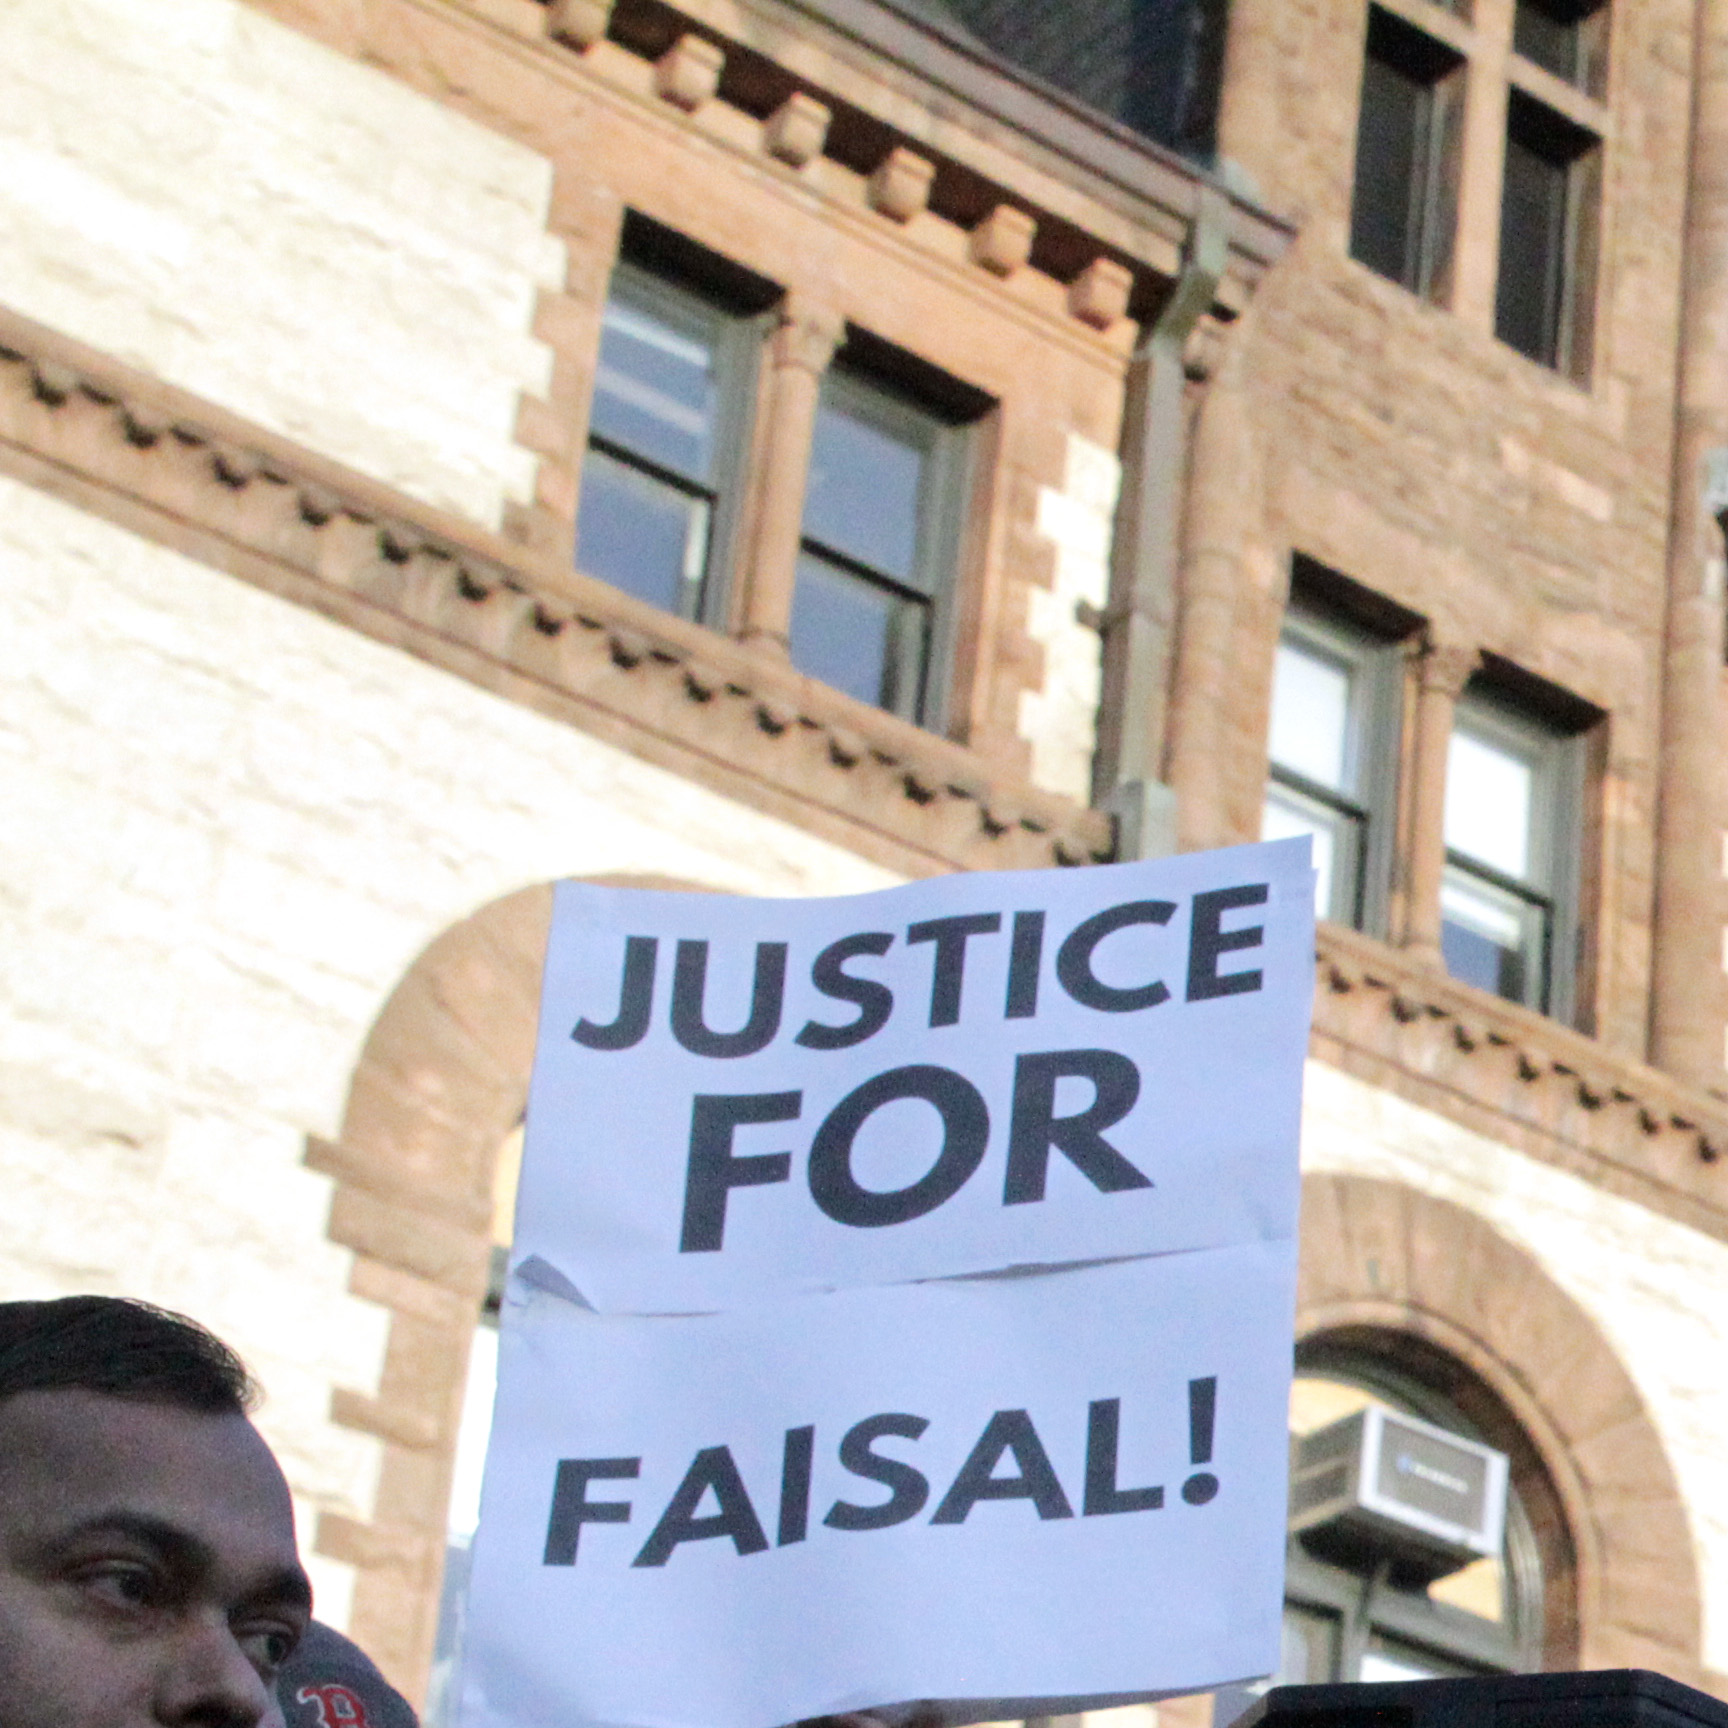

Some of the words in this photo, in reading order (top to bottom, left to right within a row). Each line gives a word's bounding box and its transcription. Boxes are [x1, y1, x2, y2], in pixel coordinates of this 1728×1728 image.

[572, 884, 1270, 1058] JUSTICE
[680, 1048, 1154, 1252] FOR
[543, 1376, 1220, 1568] FAISAL!
